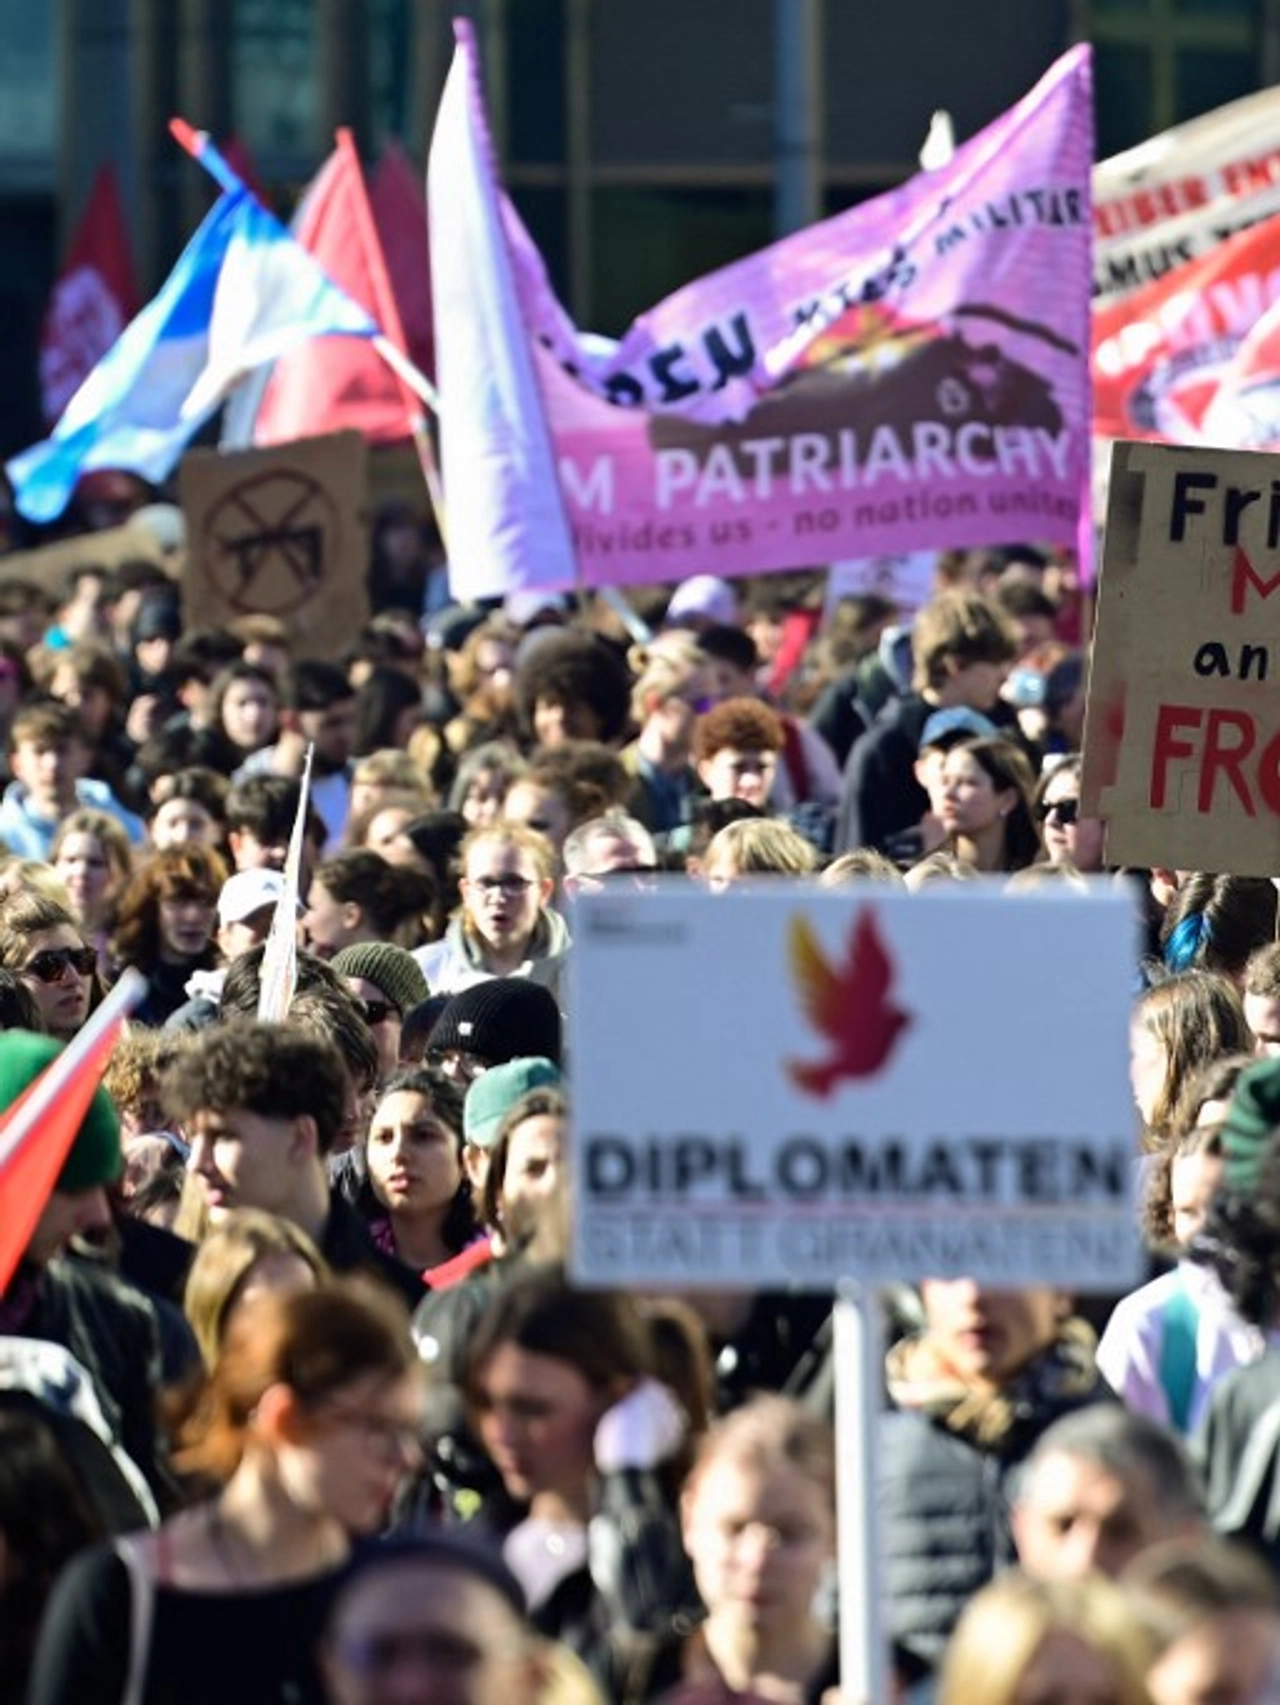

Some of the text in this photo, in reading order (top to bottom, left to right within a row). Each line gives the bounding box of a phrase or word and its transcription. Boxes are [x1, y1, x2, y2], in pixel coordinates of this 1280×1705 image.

[655, 420, 1072, 513] PATRIARCHY
[709, 517, 752, 547] us
[794, 506, 840, 538] no
[855, 489, 978, 528] nation
[1193, 641, 1269, 681] an
[584, 1136, 1126, 1200] DIPLOMATEN
